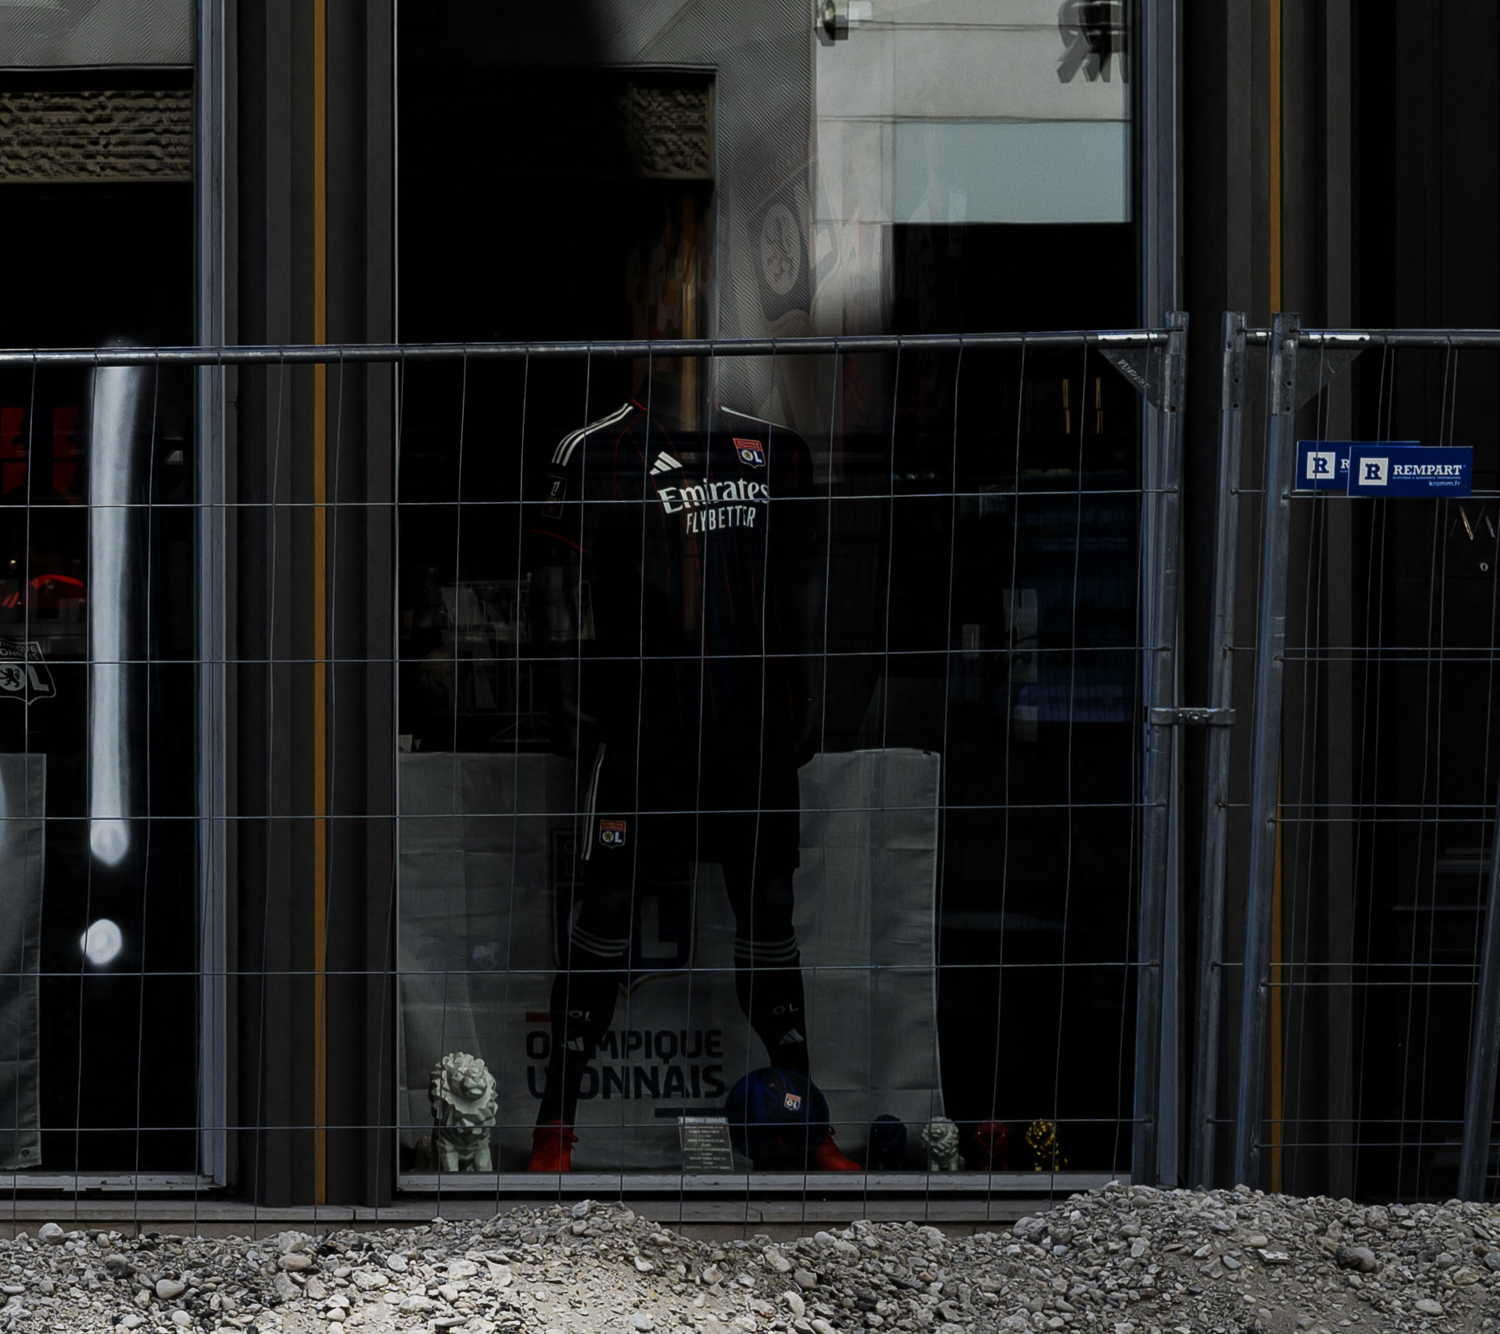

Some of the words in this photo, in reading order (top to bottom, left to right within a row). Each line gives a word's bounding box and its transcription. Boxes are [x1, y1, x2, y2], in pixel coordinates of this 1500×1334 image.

[1393, 464, 1462, 476] REMPART
[656, 477, 770, 515] Emirates
[685, 506, 757, 536] FLYBETTER
[526, 1030, 724, 1063] OMPIQUE
